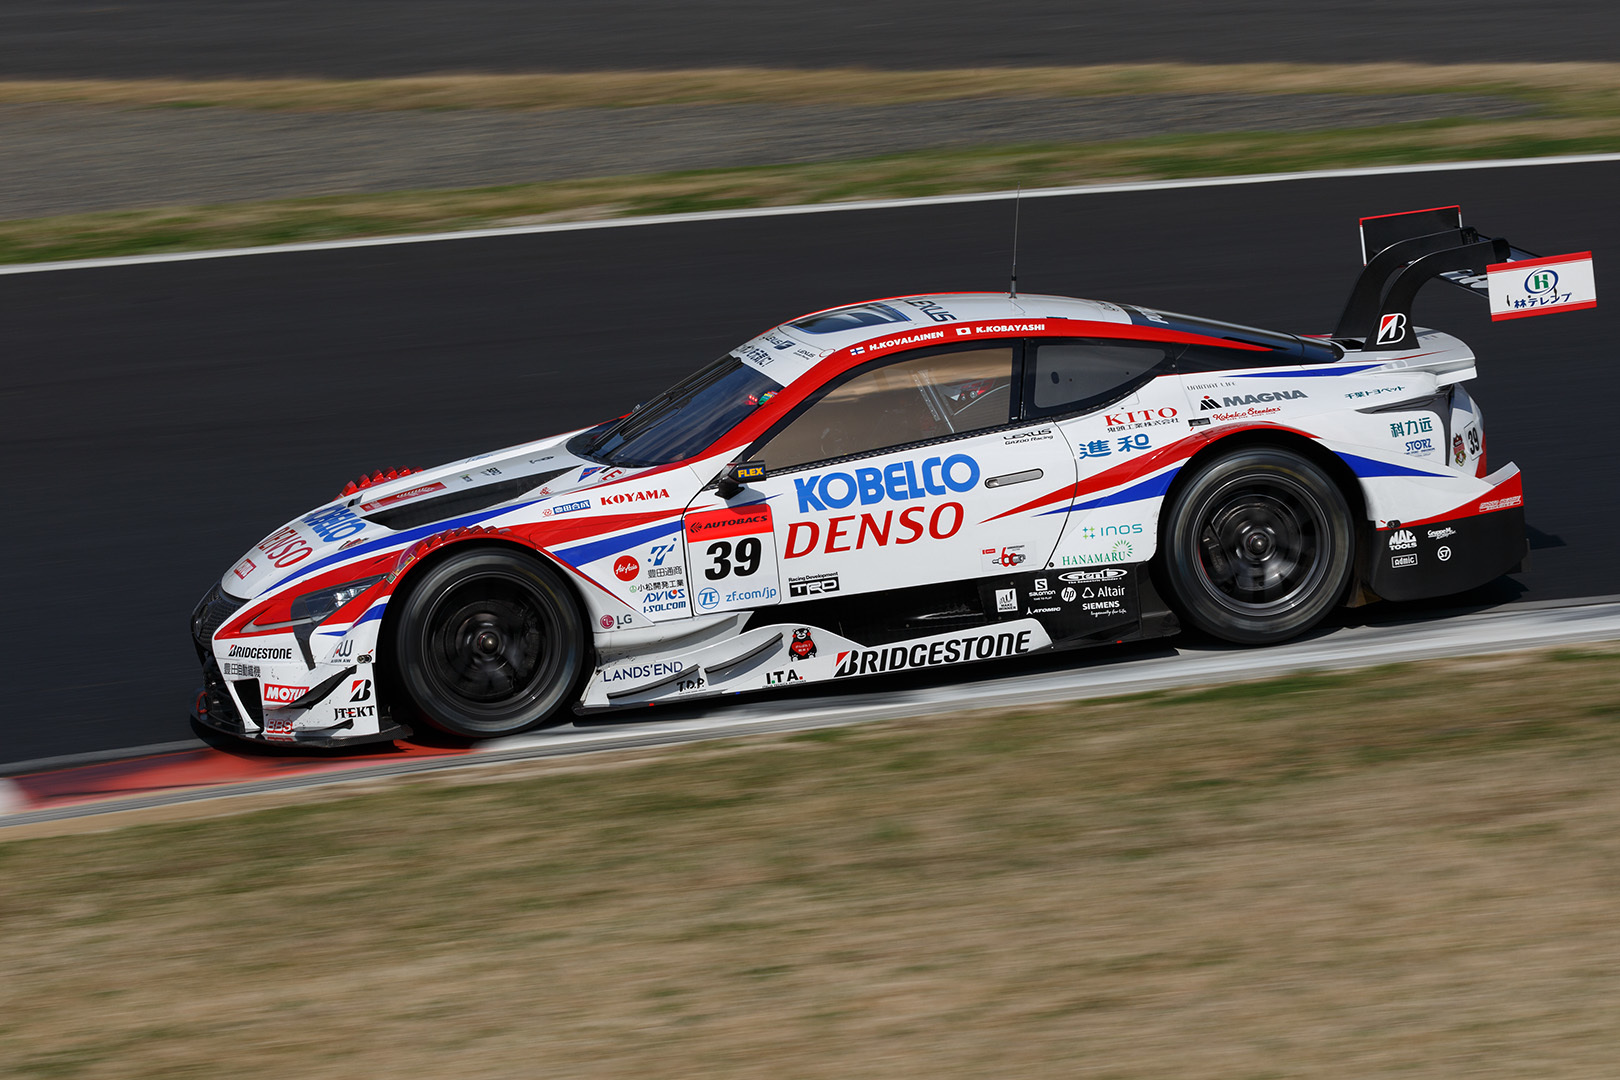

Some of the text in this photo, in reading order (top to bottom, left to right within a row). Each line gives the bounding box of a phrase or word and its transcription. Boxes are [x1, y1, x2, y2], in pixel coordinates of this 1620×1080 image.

[976, 324, 1045, 333] K.KOBAYASHI
[869, 331, 944, 351] H.KOVALAINEN
[1223, 390, 1308, 407] MAGNA
[1105, 407, 1178, 426] KITO
[1390, 417, 1433, 437] 科力远
[1405, 438, 1432, 451] STORZ
[1468, 427, 1480, 455] 39
[738, 467, 764, 478] FLEX
[794, 453, 980, 514] KOBELCO
[601, 488, 670, 506] KOYAMA
[704, 515, 768, 530] AUTOBACS
[784, 502, 964, 560] DENSO
[1389, 529, 1417, 546] MAC
[1389, 542, 1418, 550] TOOLS
[705, 537, 762, 581] 39
[1062, 551, 1126, 566] HANAMARU
[806, 571, 839, 580] Development
[725, 587, 777, 602] zf.com/jp
[791, 580, 838, 596] TRD
[1097, 585, 1126, 597] Altair
[1082, 600, 1121, 611] SIEMENS
[617, 614, 632, 624] LG
[228, 644, 293, 660] BRIDGESTONE
[834, 630, 1031, 678] BRIDGESTONE
[266, 718, 293, 734] BBS
